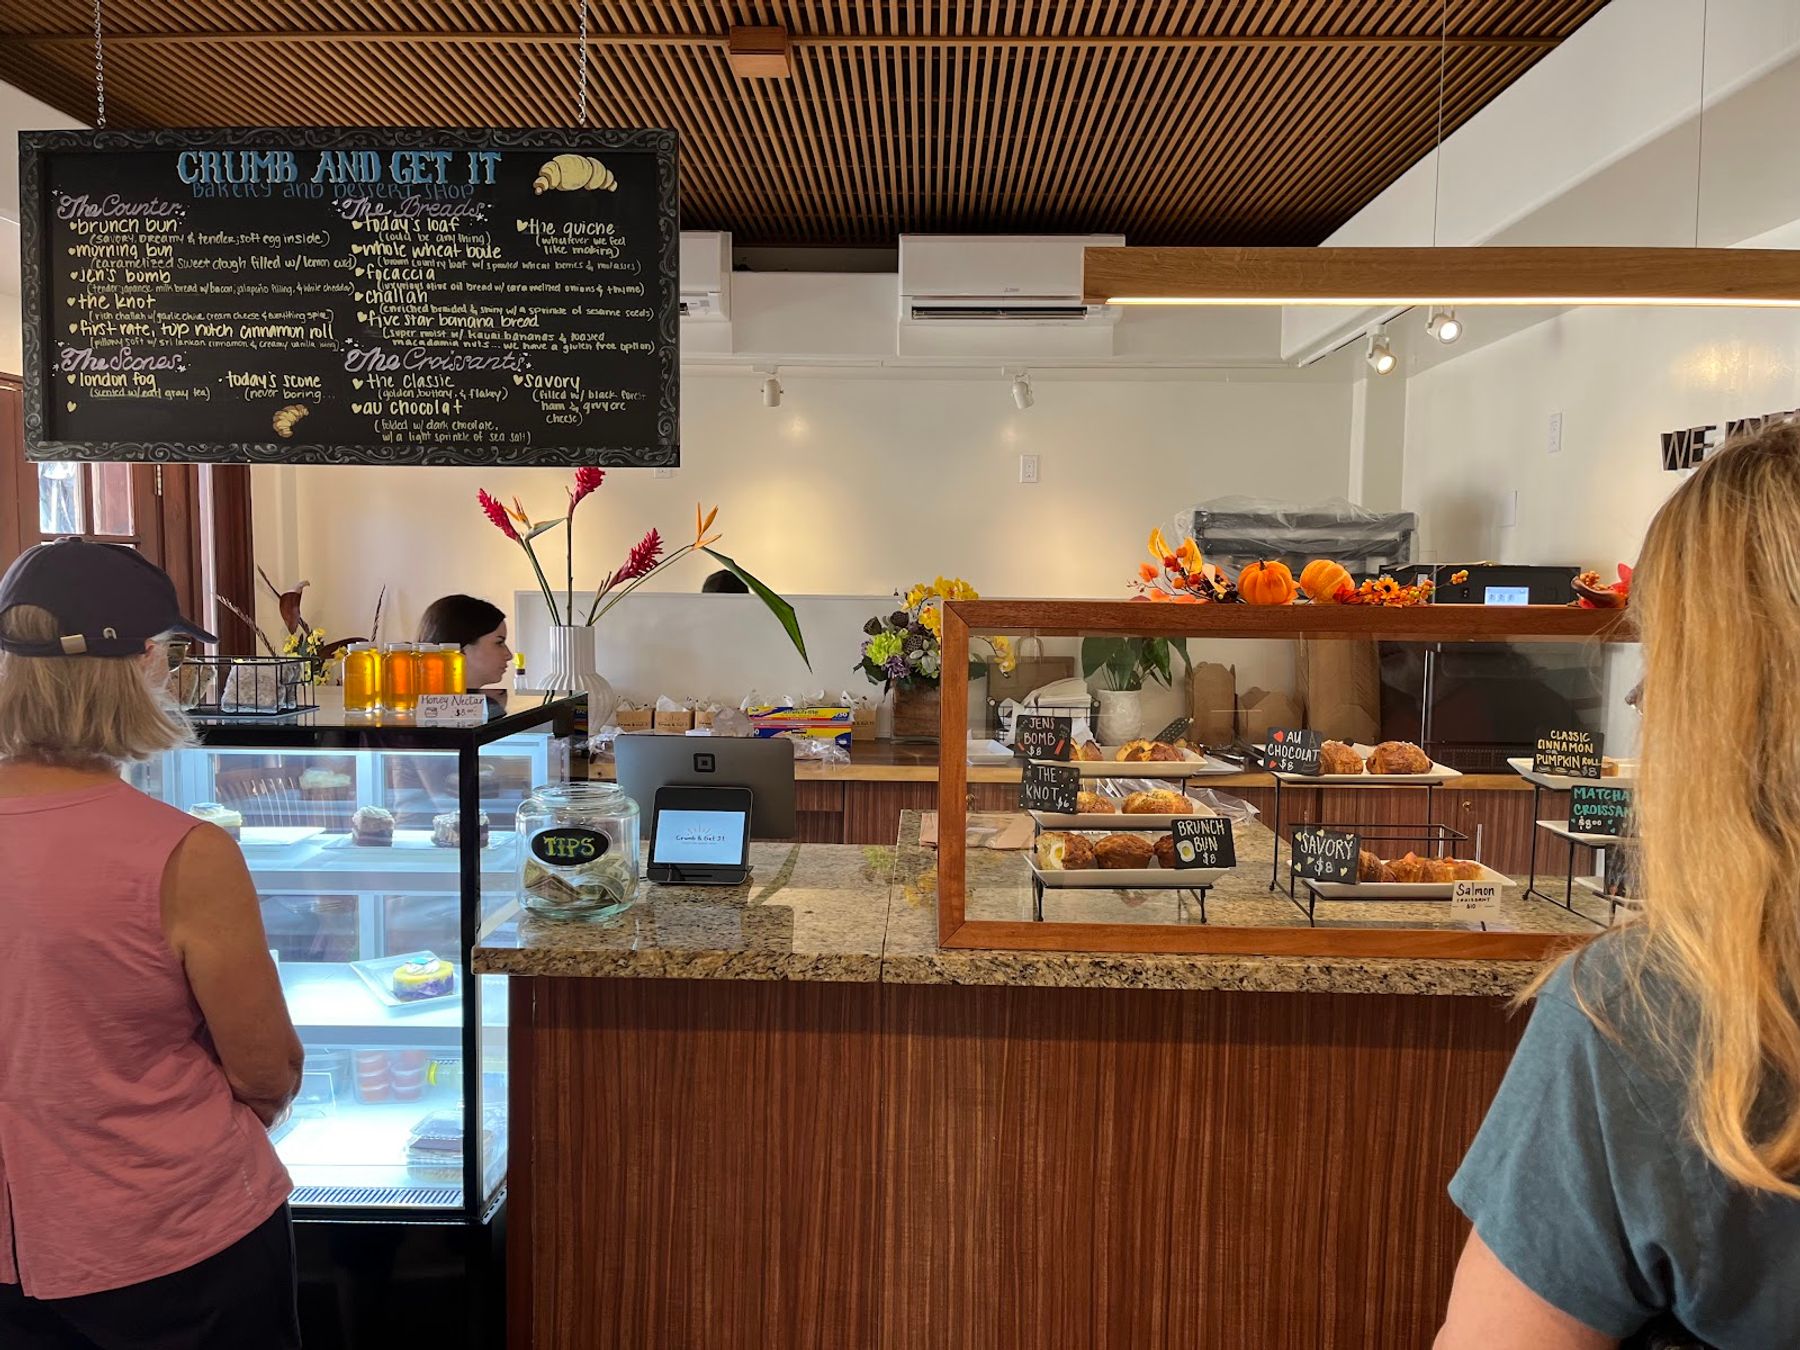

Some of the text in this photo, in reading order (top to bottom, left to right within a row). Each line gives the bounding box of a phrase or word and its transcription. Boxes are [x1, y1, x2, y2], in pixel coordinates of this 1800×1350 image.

[176, 150, 503, 184] CRUMB AND GET IT
[57, 194, 182, 219] The Counter
[341, 194, 486, 220] The Breads
[77, 217, 178, 234] brunch bun
[365, 216, 461, 233] today's loaf
[528, 218, 616, 239] the quiche
[263, 235, 281, 248] egg
[284, 230, 330, 248] inside)
[76, 243, 173, 259] morning bun
[362, 241, 407, 257] whole
[412, 242, 462, 258] wheat
[544, 245, 568, 255] like
[90, 256, 174, 270] (caramelized
[212, 257, 246, 273] dough
[251, 255, 281, 269] filled
[285, 255, 301, 270] w/
[303, 255, 330, 268] lemon
[367, 263, 436, 281] focaccia
[125, 268, 171, 283] bomb
[78, 293, 156, 309] the knot
[366, 289, 428, 304] challah
[115, 312, 146, 321] challah
[367, 310, 540, 328] five star banana bread
[80, 320, 334, 339] first rate, top notch cinnamon roll
[61, 347, 182, 371] The Scones
[344, 347, 525, 372] The Croissants
[80, 372, 157, 391] london fog
[226, 371, 322, 388] today's scone
[367, 373, 455, 389] the classic
[244, 387, 278, 401] (never
[362, 399, 463, 415] au chocolat
[541, 401, 566, 411] ham
[546, 411, 583, 427] cheese)
[1660, 425, 1716, 471] WE
[421, 695, 485, 711] Honey Nectar
[1029, 717, 1056, 730] JENS
[1023, 732, 1056, 746] BOMB
[1286, 731, 1302, 745] AU
[1550, 730, 1590, 743] CLASSIC
[1026, 745, 1042, 757] $8
[1267, 743, 1321, 762] CHOCOLAT
[1537, 739, 1594, 754] CINNAMON
[1278, 758, 1294, 771] $8
[1536, 753, 1602, 769] PUMPKIN ROLL
[1037, 766, 1057, 783] THE
[1582, 766, 1598, 777] $8
[1025, 784, 1060, 801] KNOT
[1573, 787, 1632, 803] MATCHA
[1056, 797, 1070, 810] $6
[1573, 804, 1633, 818] CROISSAN
[1177, 819, 1225, 836] BRUNCH
[543, 836, 595, 858] TIPS
[1193, 836, 1218, 852] BUN
[1300, 832, 1354, 861] SAVORY
[1202, 851, 1217, 866] $8
[1314, 856, 1334, 876] $8
[1456, 882, 1495, 896] Salmon
